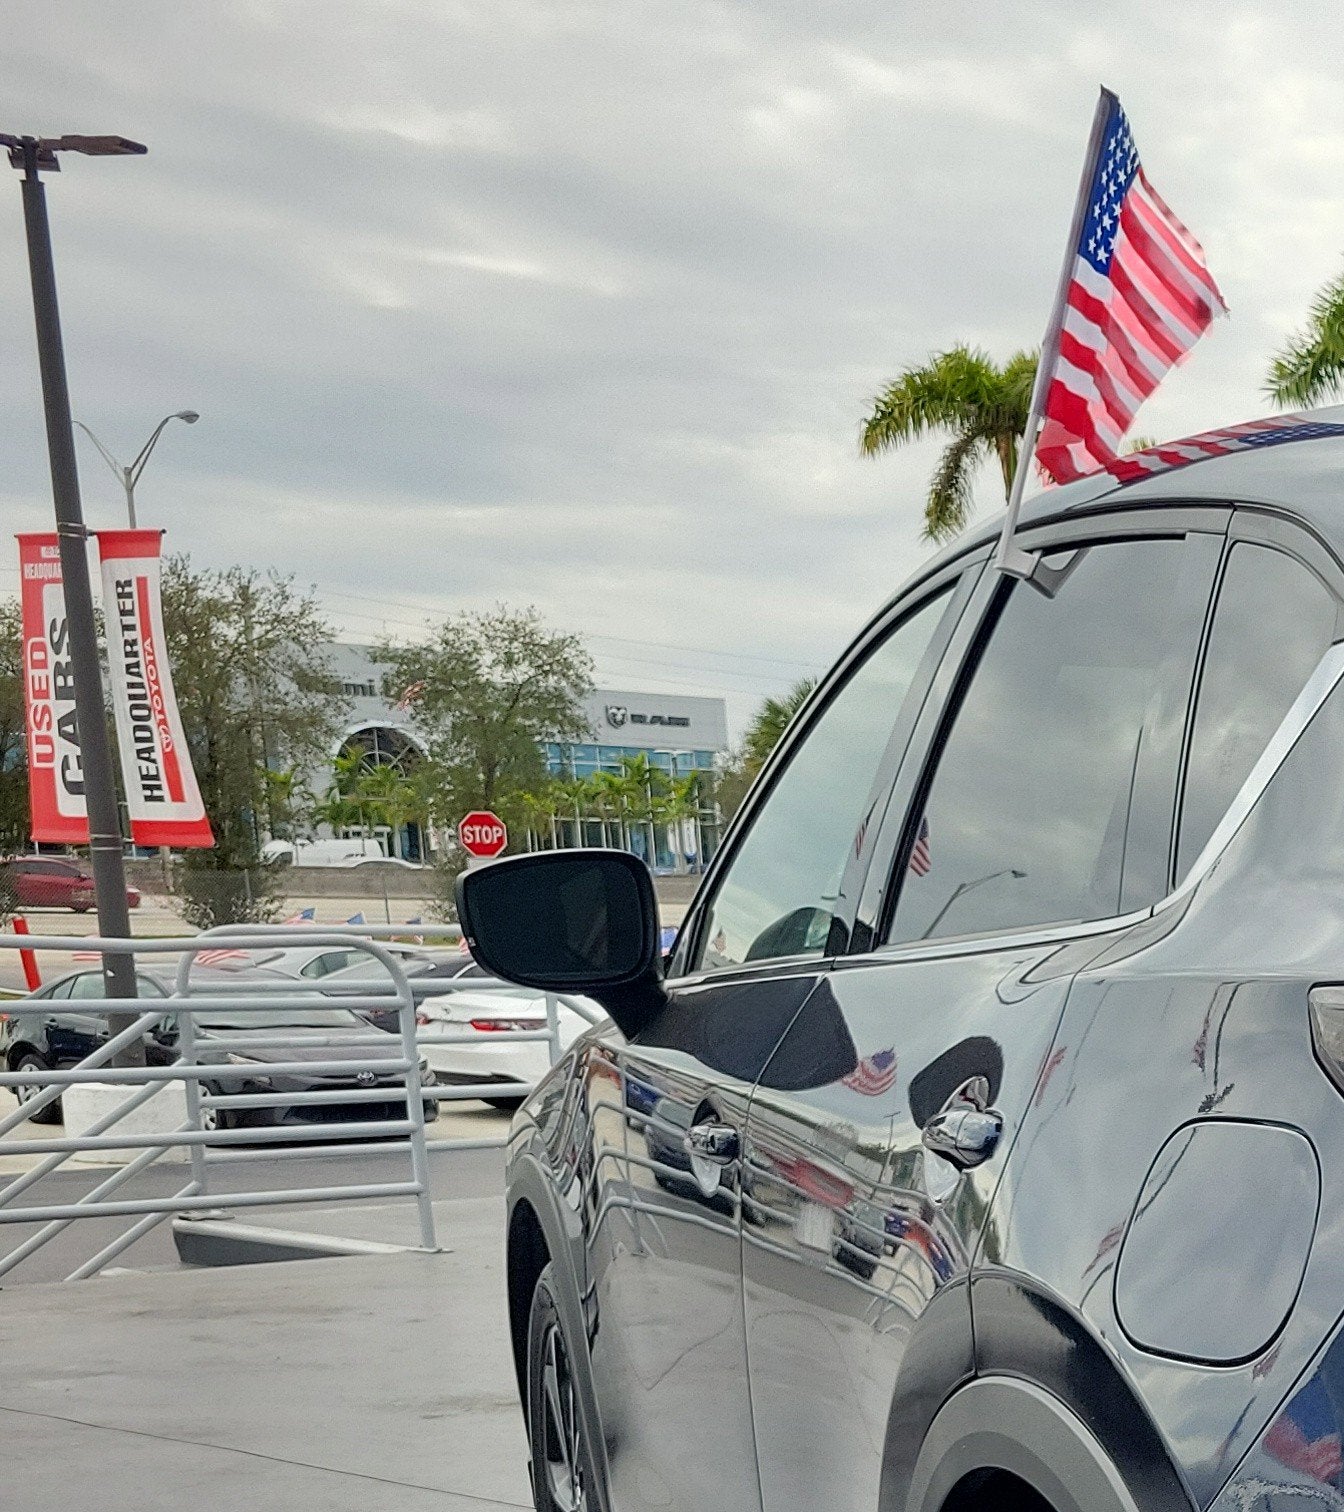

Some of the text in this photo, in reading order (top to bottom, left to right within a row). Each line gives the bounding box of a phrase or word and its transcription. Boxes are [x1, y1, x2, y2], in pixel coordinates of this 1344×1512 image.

[28, 638, 54, 768] USED
[50, 616, 87, 796] CARS
[115, 578, 166, 802] HEADQUARTER
[143, 637, 166, 722] TOYOTA
[463, 825, 503, 844] STOP
